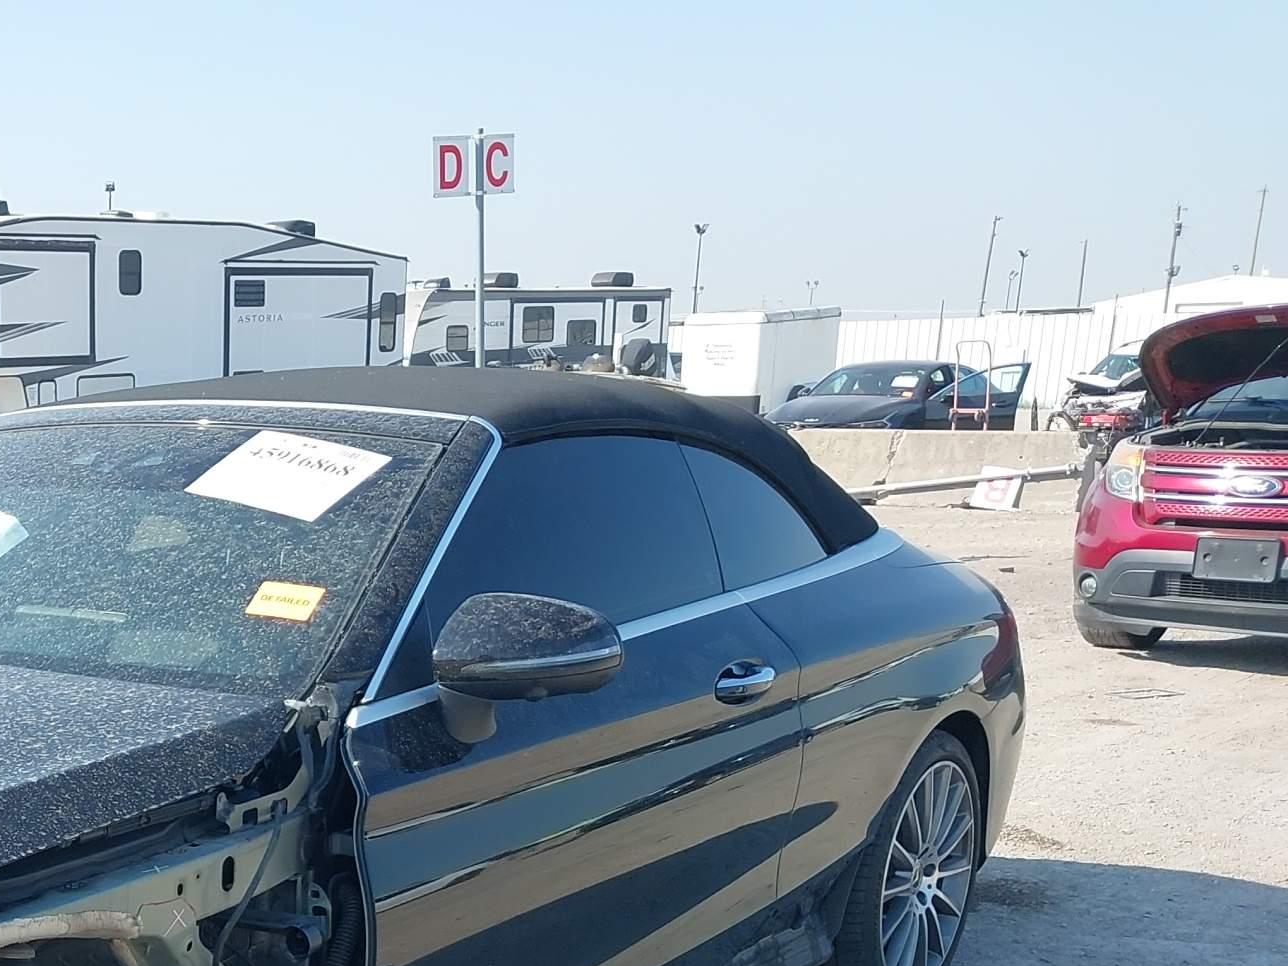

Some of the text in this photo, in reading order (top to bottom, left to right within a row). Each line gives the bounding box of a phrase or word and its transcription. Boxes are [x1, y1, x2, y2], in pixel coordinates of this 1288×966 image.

[440, 144, 463, 190] D
[485, 141, 509, 188] C
[237, 313, 284, 324] ASTORIA
[249, 447, 356, 477] 45916868
